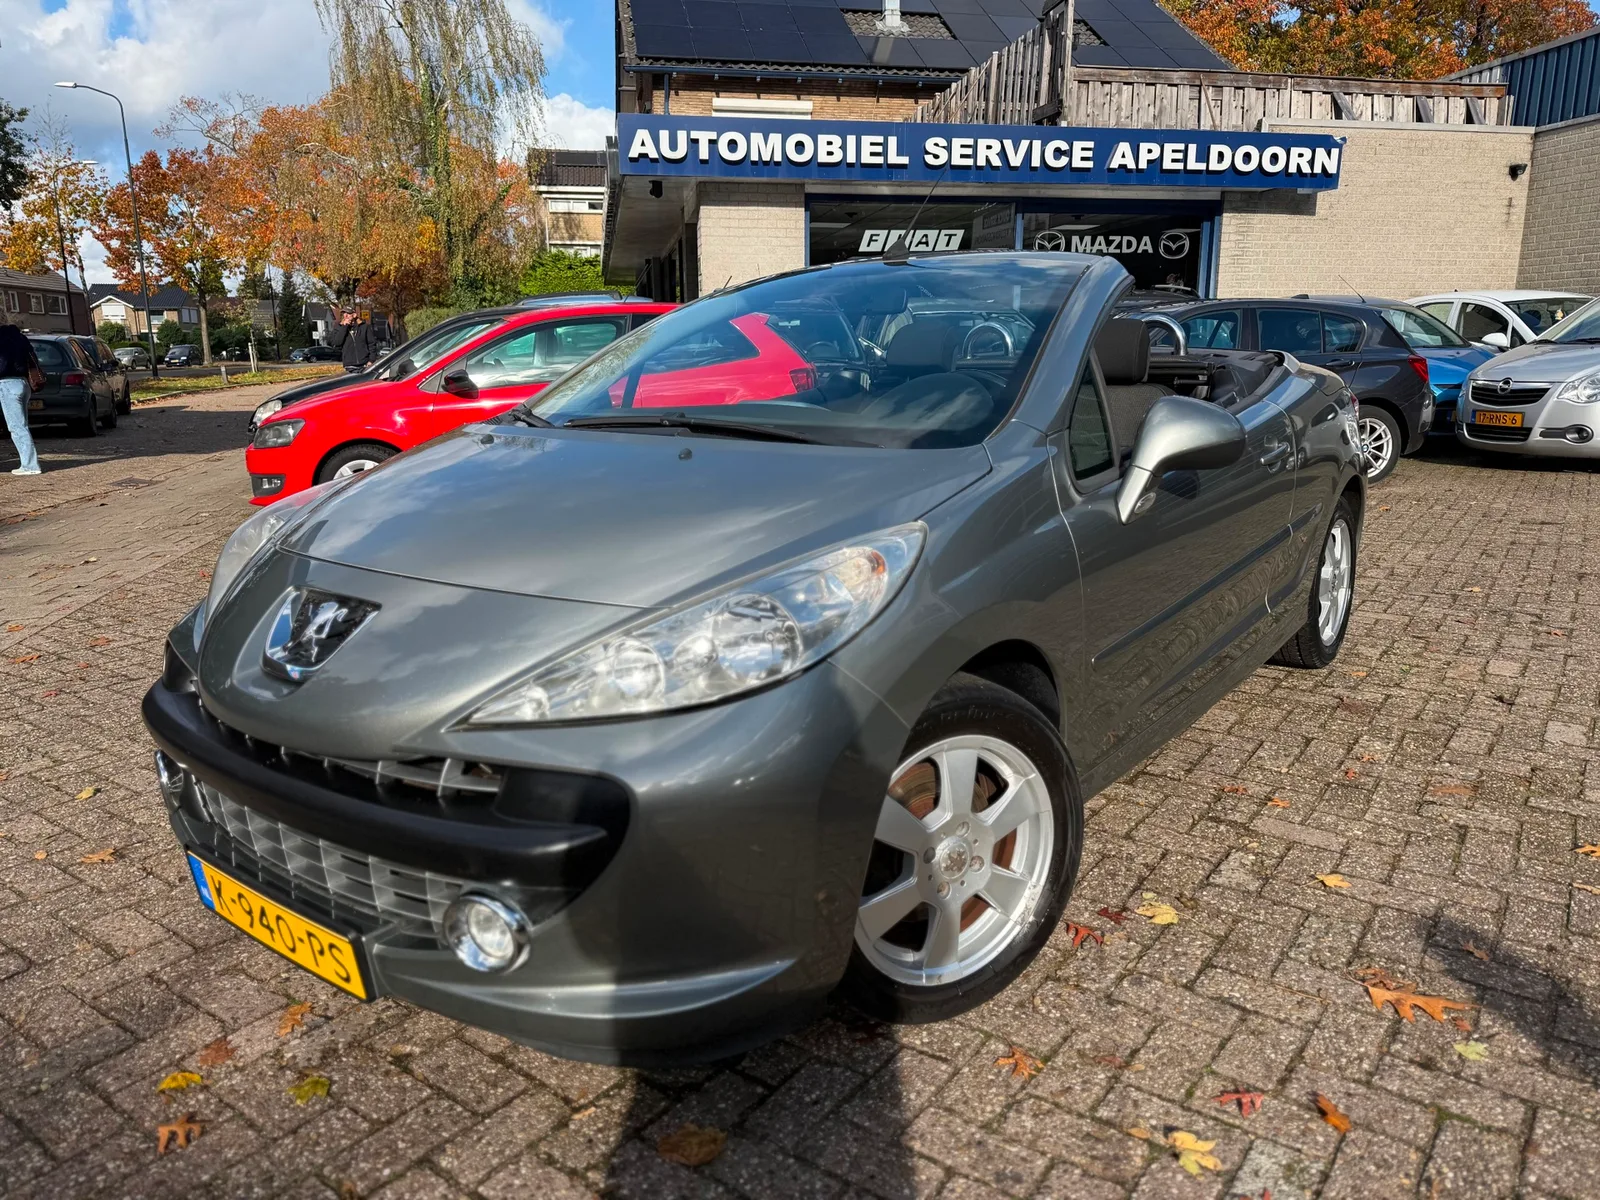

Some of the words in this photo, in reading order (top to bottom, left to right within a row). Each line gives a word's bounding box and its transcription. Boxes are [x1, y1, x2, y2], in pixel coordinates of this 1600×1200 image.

[628, 128, 909, 165] AUTOMOBIEL
[923, 137, 1095, 168] SERVICE
[1108, 142, 1340, 174] APELDOORN
[1070, 235, 1154, 254] MAZDA
[210, 873, 352, 984] K-940-PS
